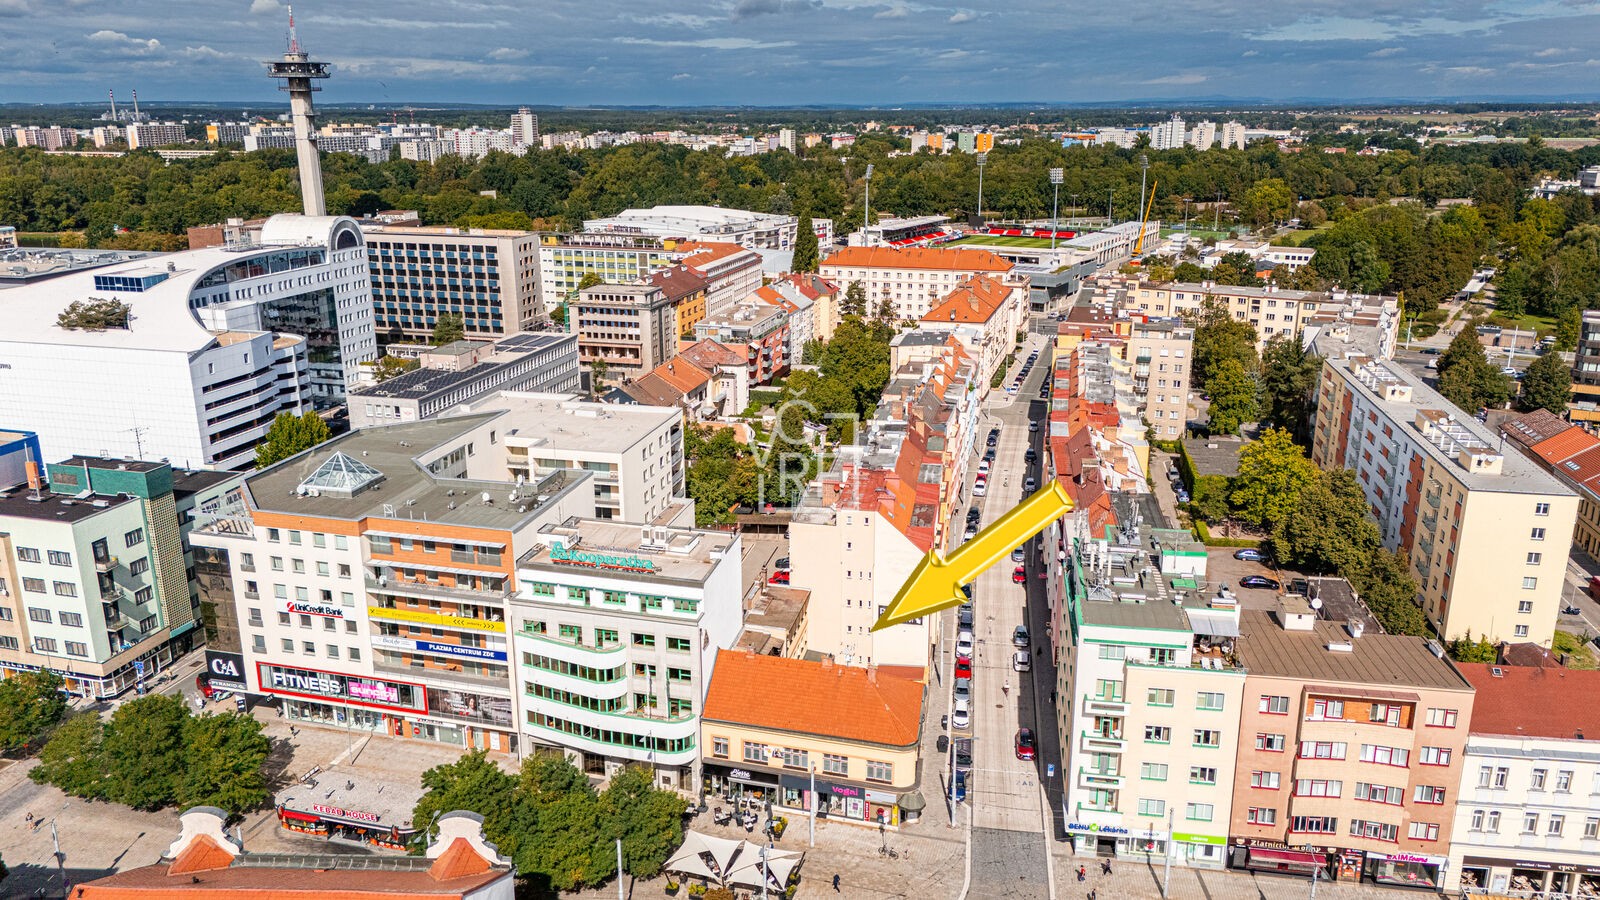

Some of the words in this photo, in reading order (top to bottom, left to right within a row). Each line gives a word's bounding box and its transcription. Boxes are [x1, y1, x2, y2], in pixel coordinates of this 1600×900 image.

[570, 550, 653, 569] Kooperativa
[295, 602, 324, 616] UniCredit
[325, 606, 343, 617] Bank
[429, 644, 453, 653] PLAZMA
[453, 647, 482, 657] CENTRUM
[483, 650, 495, 658] ZDE
[212, 658, 239, 677] C&A
[273, 671, 341, 694] FITNESS
[350, 684, 396, 702] suncity
[313, 804, 343, 816] KEBAB
[345, 810, 378, 822] HOUSE
[1068, 823, 1089, 831] BENU
[1098, 824, 1128, 835] Lékárna
